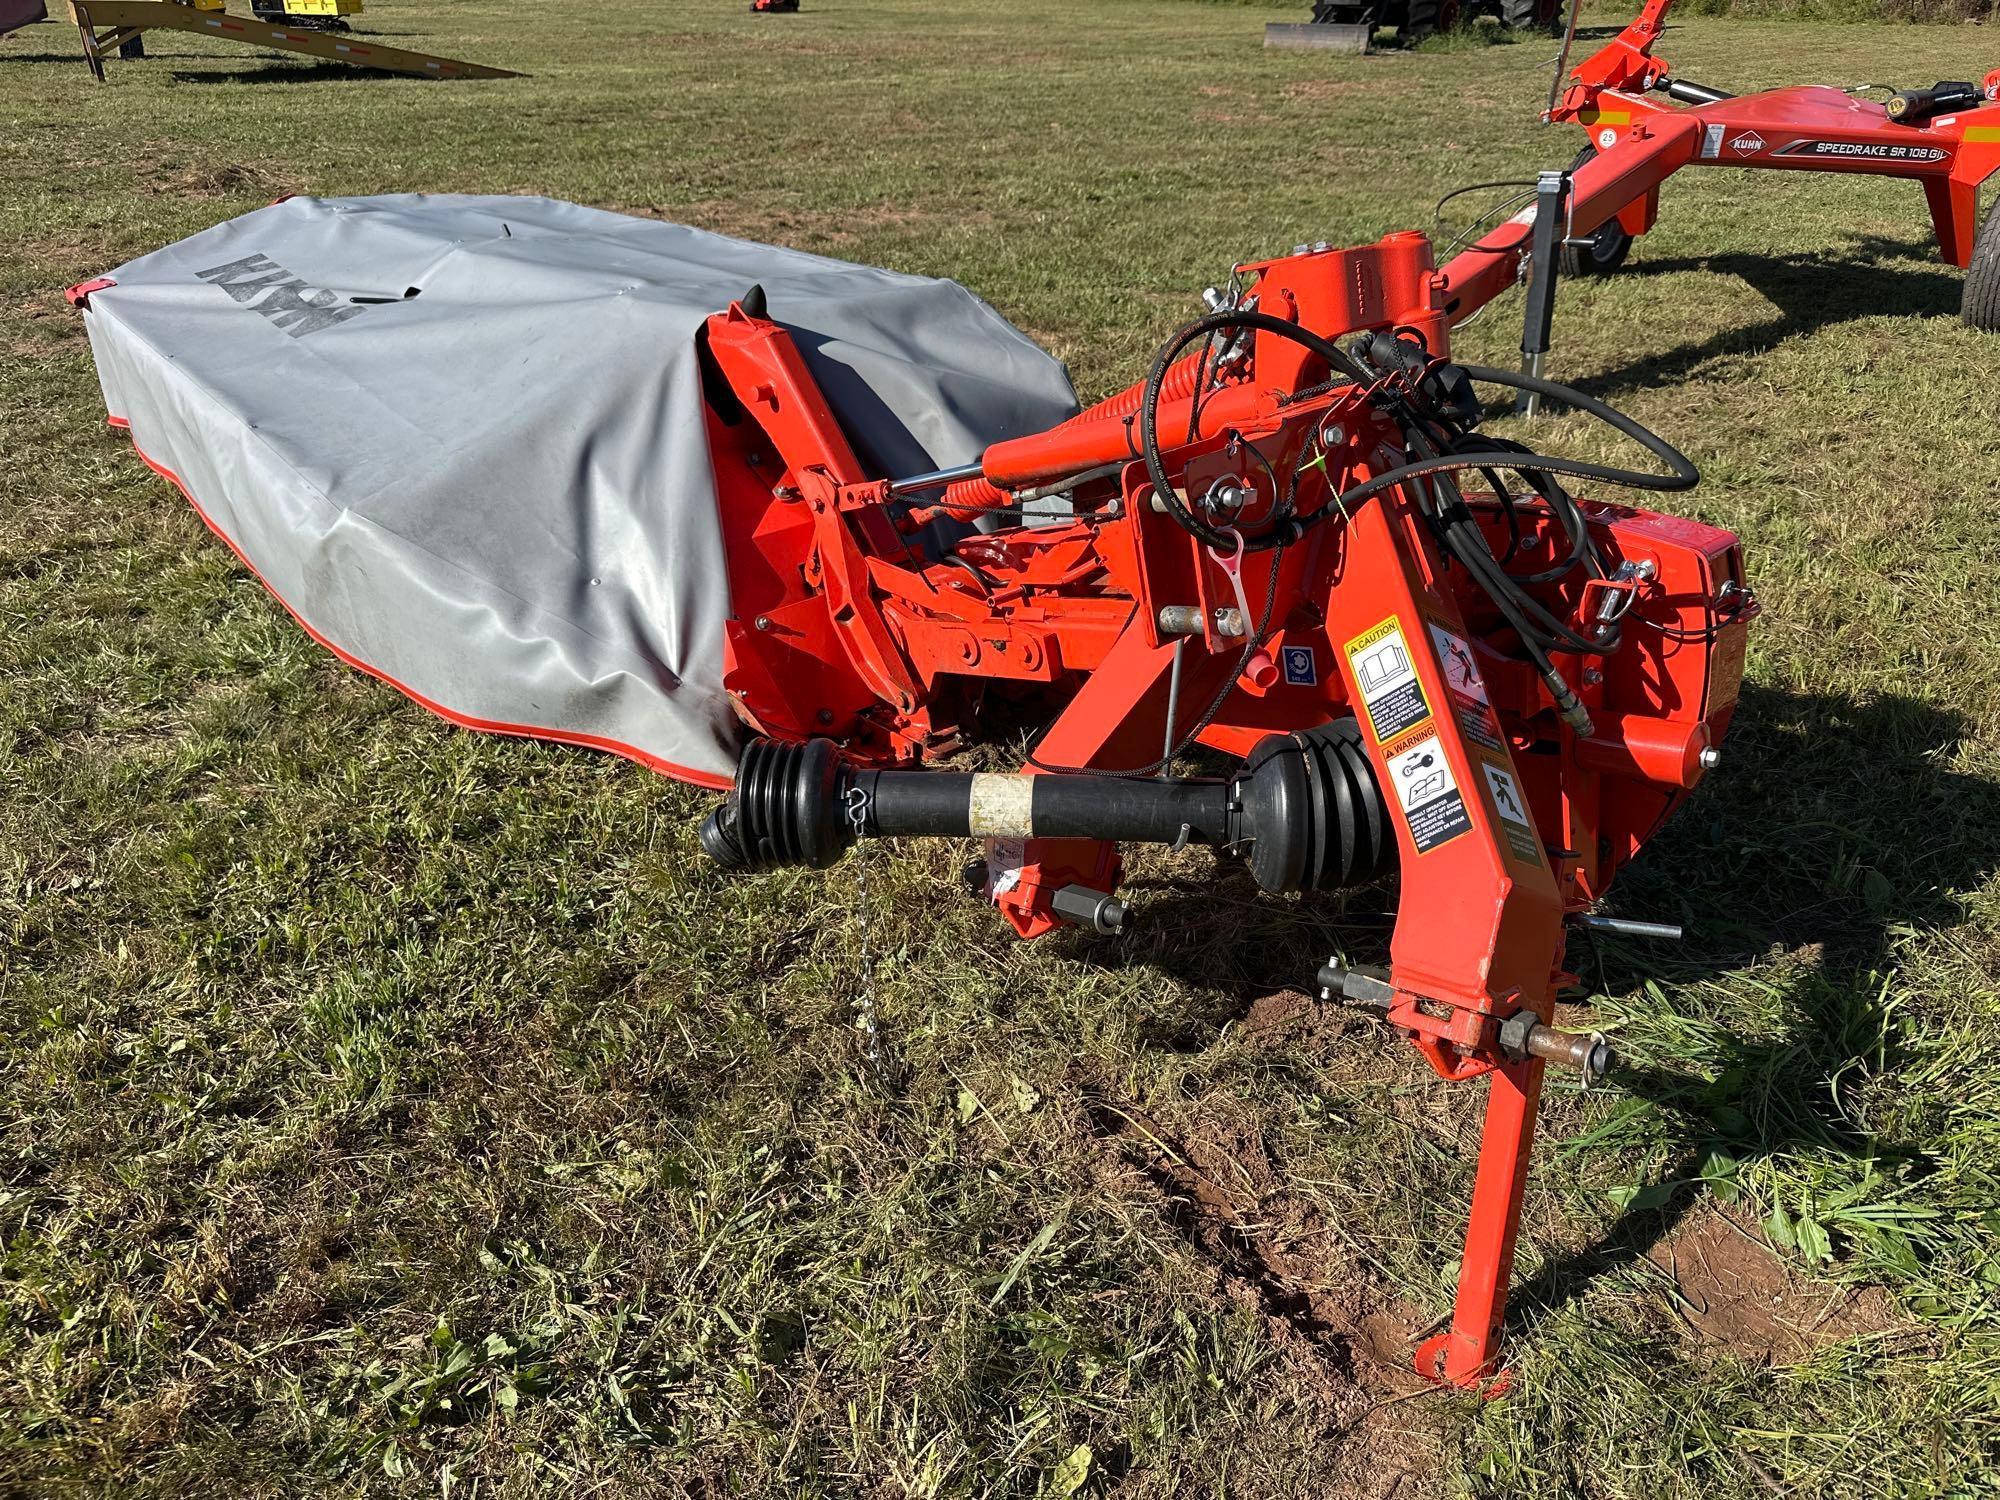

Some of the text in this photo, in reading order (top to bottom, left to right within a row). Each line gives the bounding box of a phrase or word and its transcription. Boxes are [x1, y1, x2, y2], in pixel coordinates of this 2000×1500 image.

[1602, 133, 1612, 142] 25
[1734, 139, 1762, 150] KUHN
[1816, 142, 1886, 156] SPEEDRAKE
[1890, 147, 1906, 156] SR
[1909, 148, 1928, 158] 108
[1358, 622, 1396, 648] CAUTION
[1394, 727, 1434, 754] WARNING
